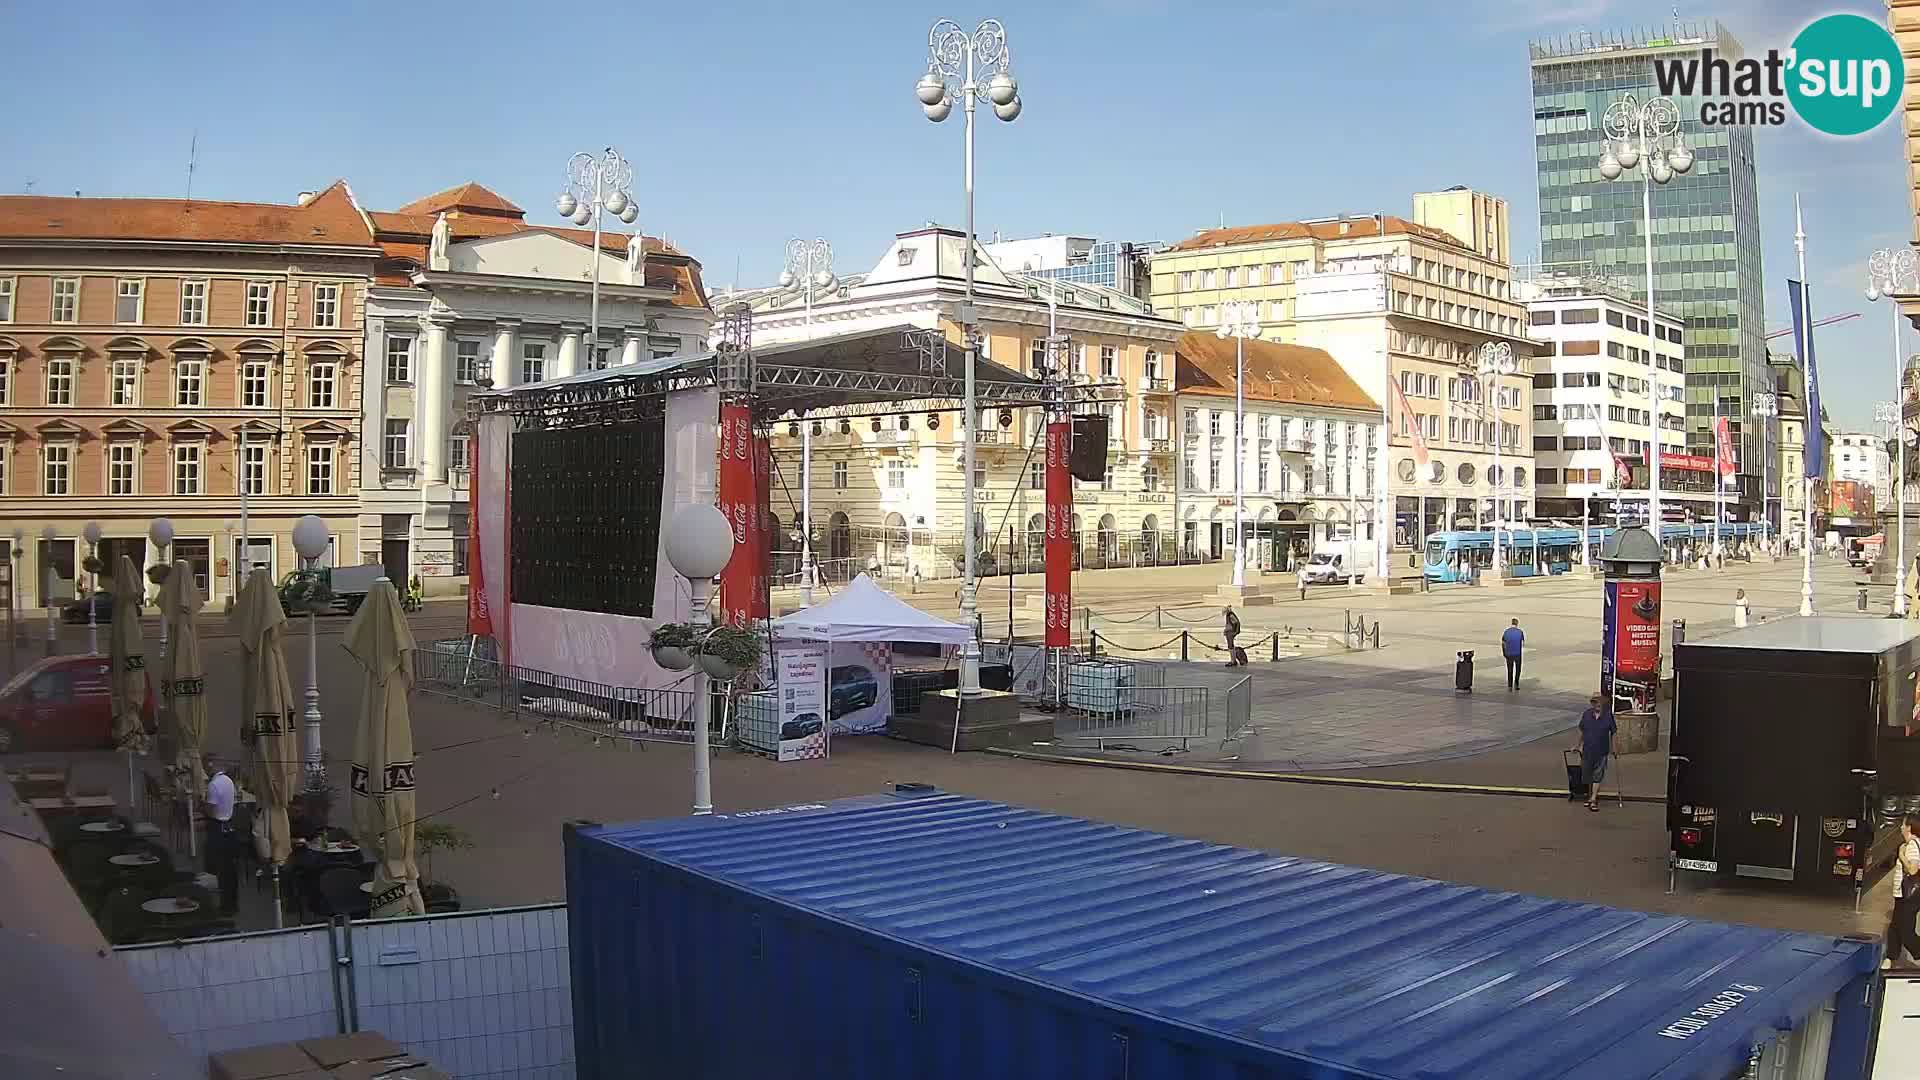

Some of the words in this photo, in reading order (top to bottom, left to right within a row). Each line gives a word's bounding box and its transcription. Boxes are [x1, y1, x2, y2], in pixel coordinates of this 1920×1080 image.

[735, 418, 748, 460] Coca-Cola
[735, 503, 747, 544] Coca-Cola
[1625, 624, 1647, 632] VIDEO
[1657, 1016, 1709, 1040] MCDU
[1691, 990, 1748, 1019] 300629
